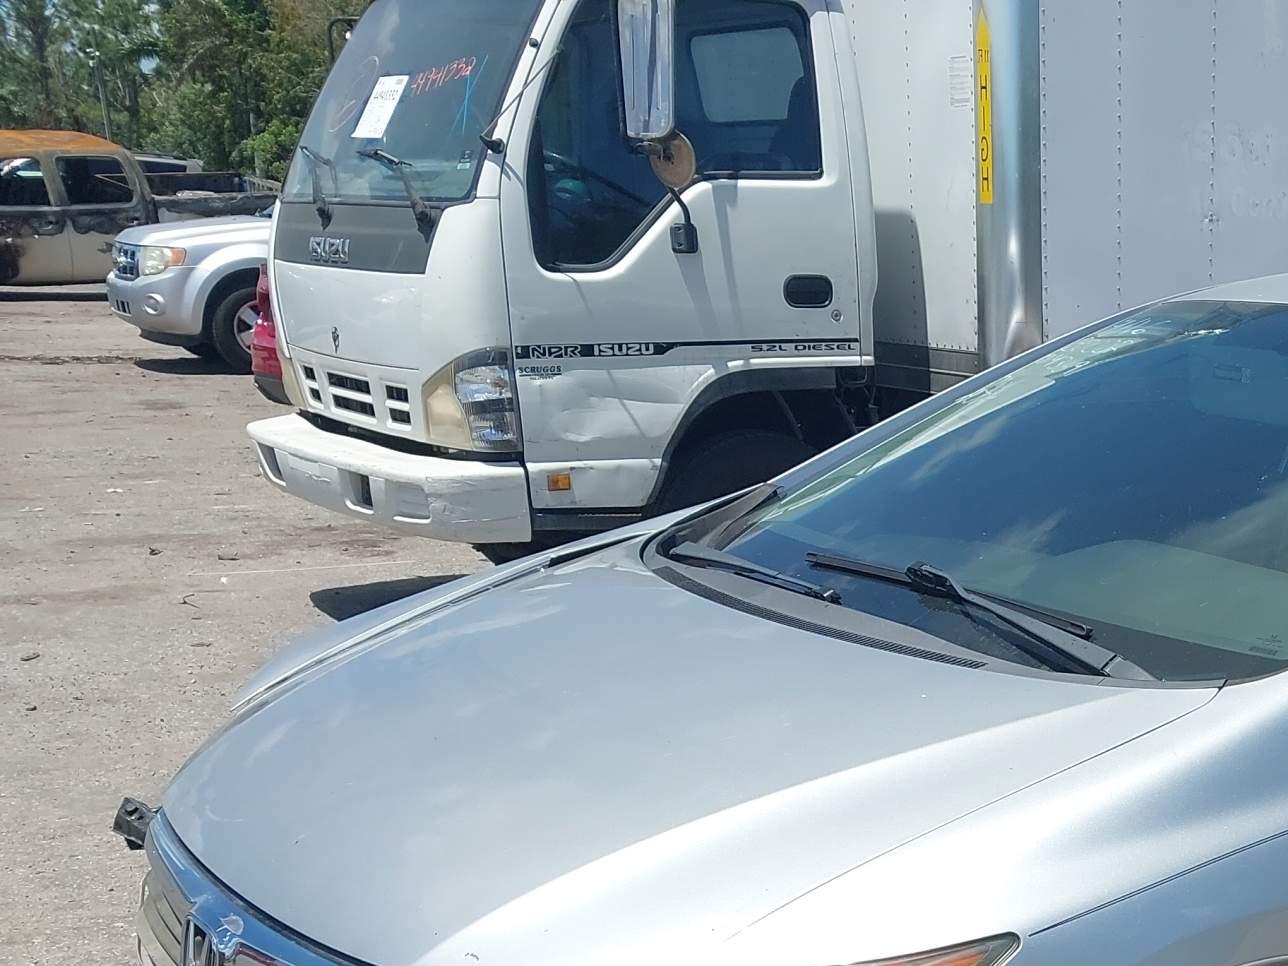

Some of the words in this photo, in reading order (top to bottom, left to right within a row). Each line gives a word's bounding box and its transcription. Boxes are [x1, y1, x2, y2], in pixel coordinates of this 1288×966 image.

[309, 236, 350, 261] ISUZU
[529, 344, 582, 360] NPR
[593, 343, 655, 357] ISUZU
[794, 343, 857, 352] DIESEL
[518, 365, 562, 374] SCRUGGS
